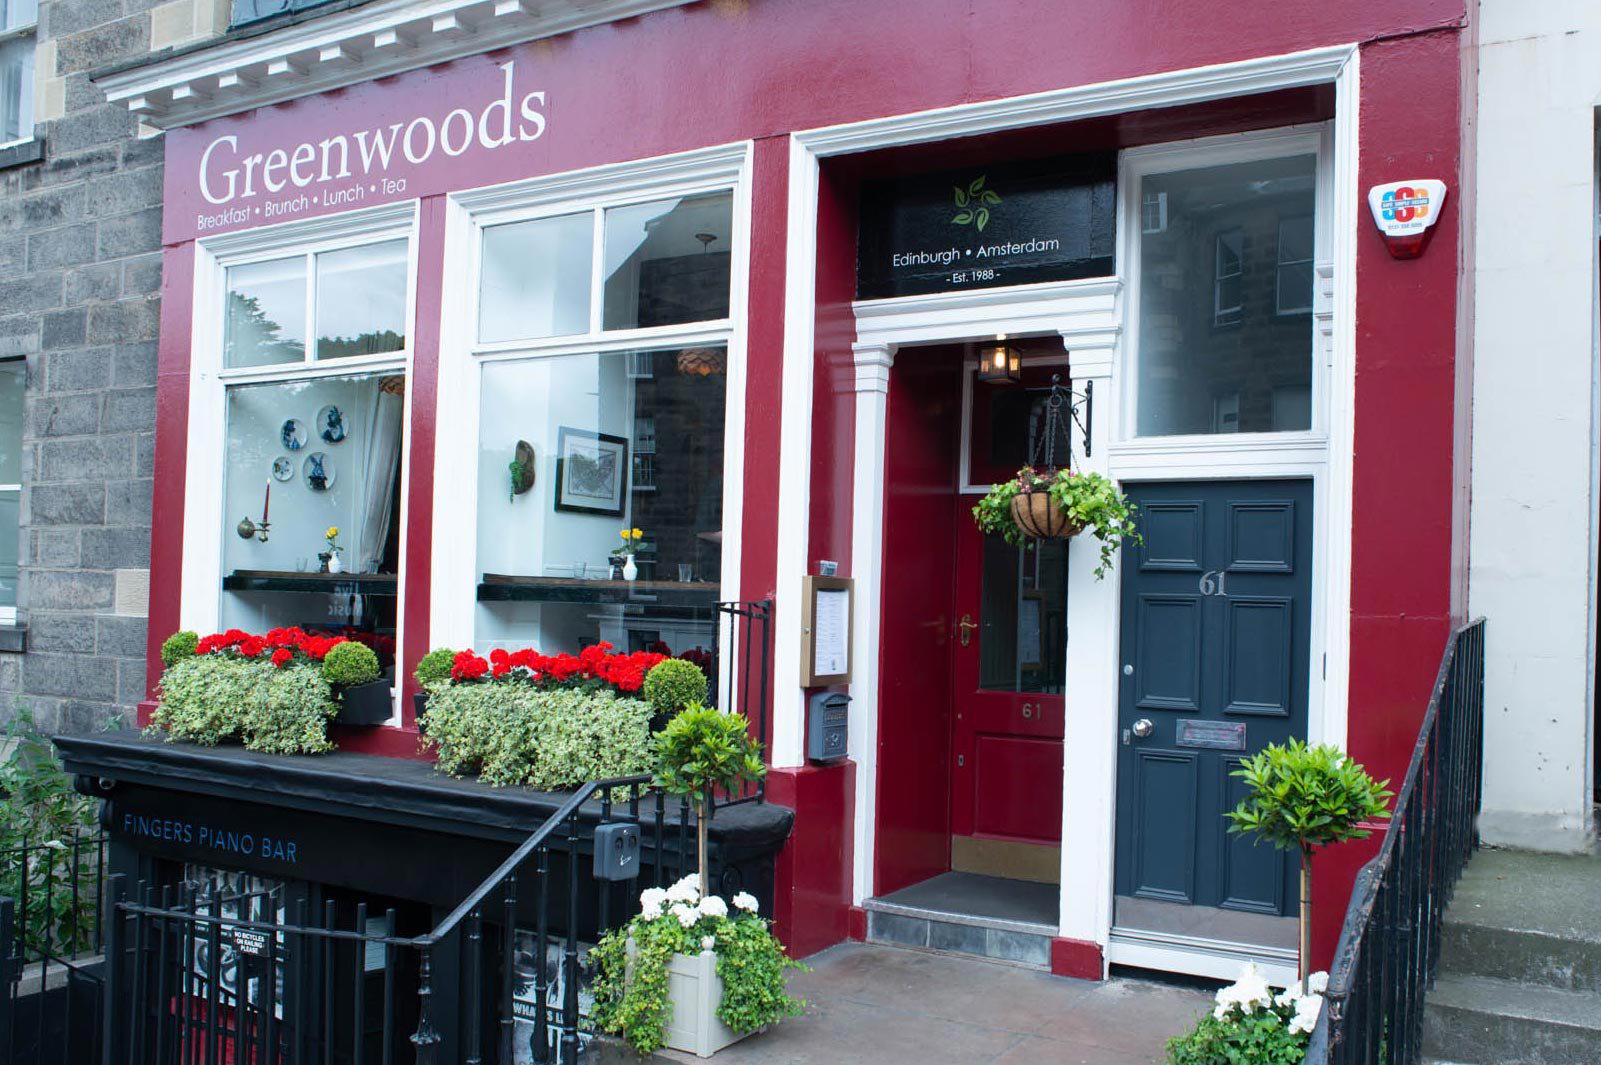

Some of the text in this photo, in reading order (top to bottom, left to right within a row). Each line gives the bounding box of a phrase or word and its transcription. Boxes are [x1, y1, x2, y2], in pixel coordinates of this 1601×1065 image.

[199, 60, 546, 204] Greenwoods
[197, 178, 406, 230] Breakfast Brunch Lunch Tea
[892, 237, 1060, 267] Edinburgh Amsterdam
[972, 269, 995, 281] 1988
[1198, 570, 1227, 596] 61
[1022, 702, 1042, 718] 61
[124, 813, 297, 864] FINGERS PIANO BAR
[240, 944, 259, 954] PLEASE
[242, 933, 264, 942] BICYCLES
